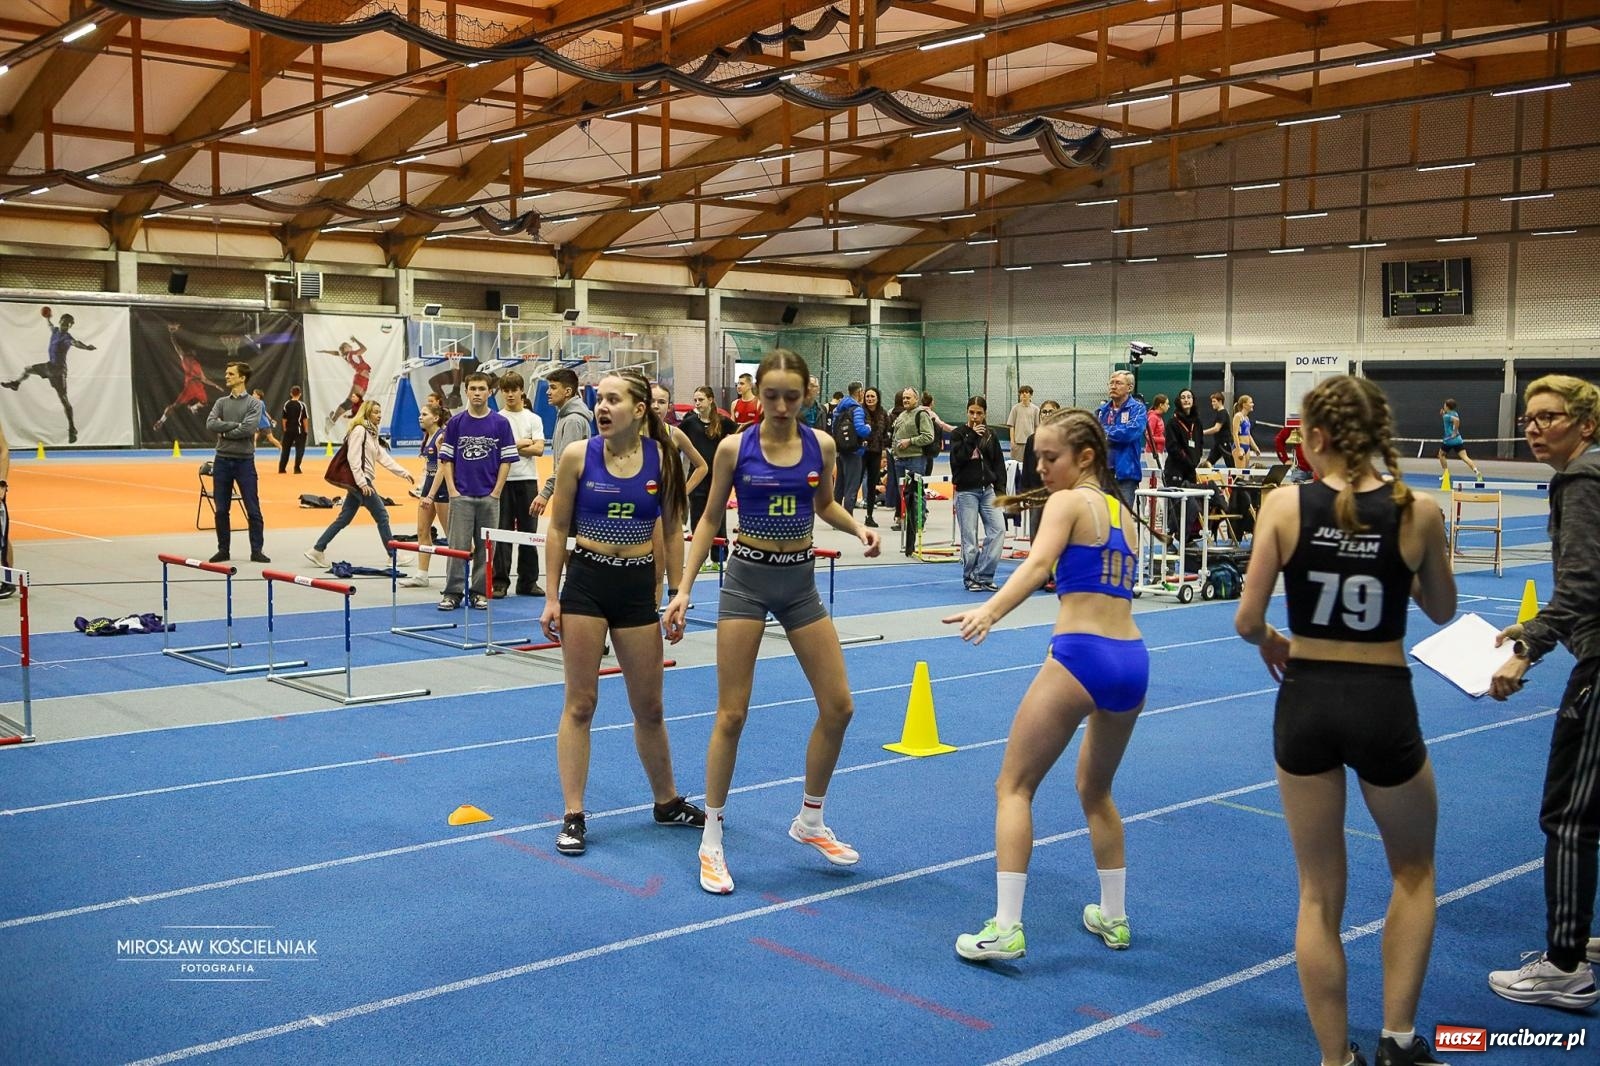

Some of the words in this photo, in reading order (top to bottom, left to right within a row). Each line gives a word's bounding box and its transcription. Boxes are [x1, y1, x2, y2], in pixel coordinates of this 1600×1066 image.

[1295, 356, 1310, 366] DO
[1311, 356, 1338, 365] METY
[607, 502, 636, 519] 22
[768, 495, 797, 516] 20
[1339, 540, 1380, 553] TEAM
[584, 552, 625, 566] NIKE
[625, 553, 654, 567] PRO
[768, 551, 805, 563] NIKE
[1307, 570, 1384, 632] 79
